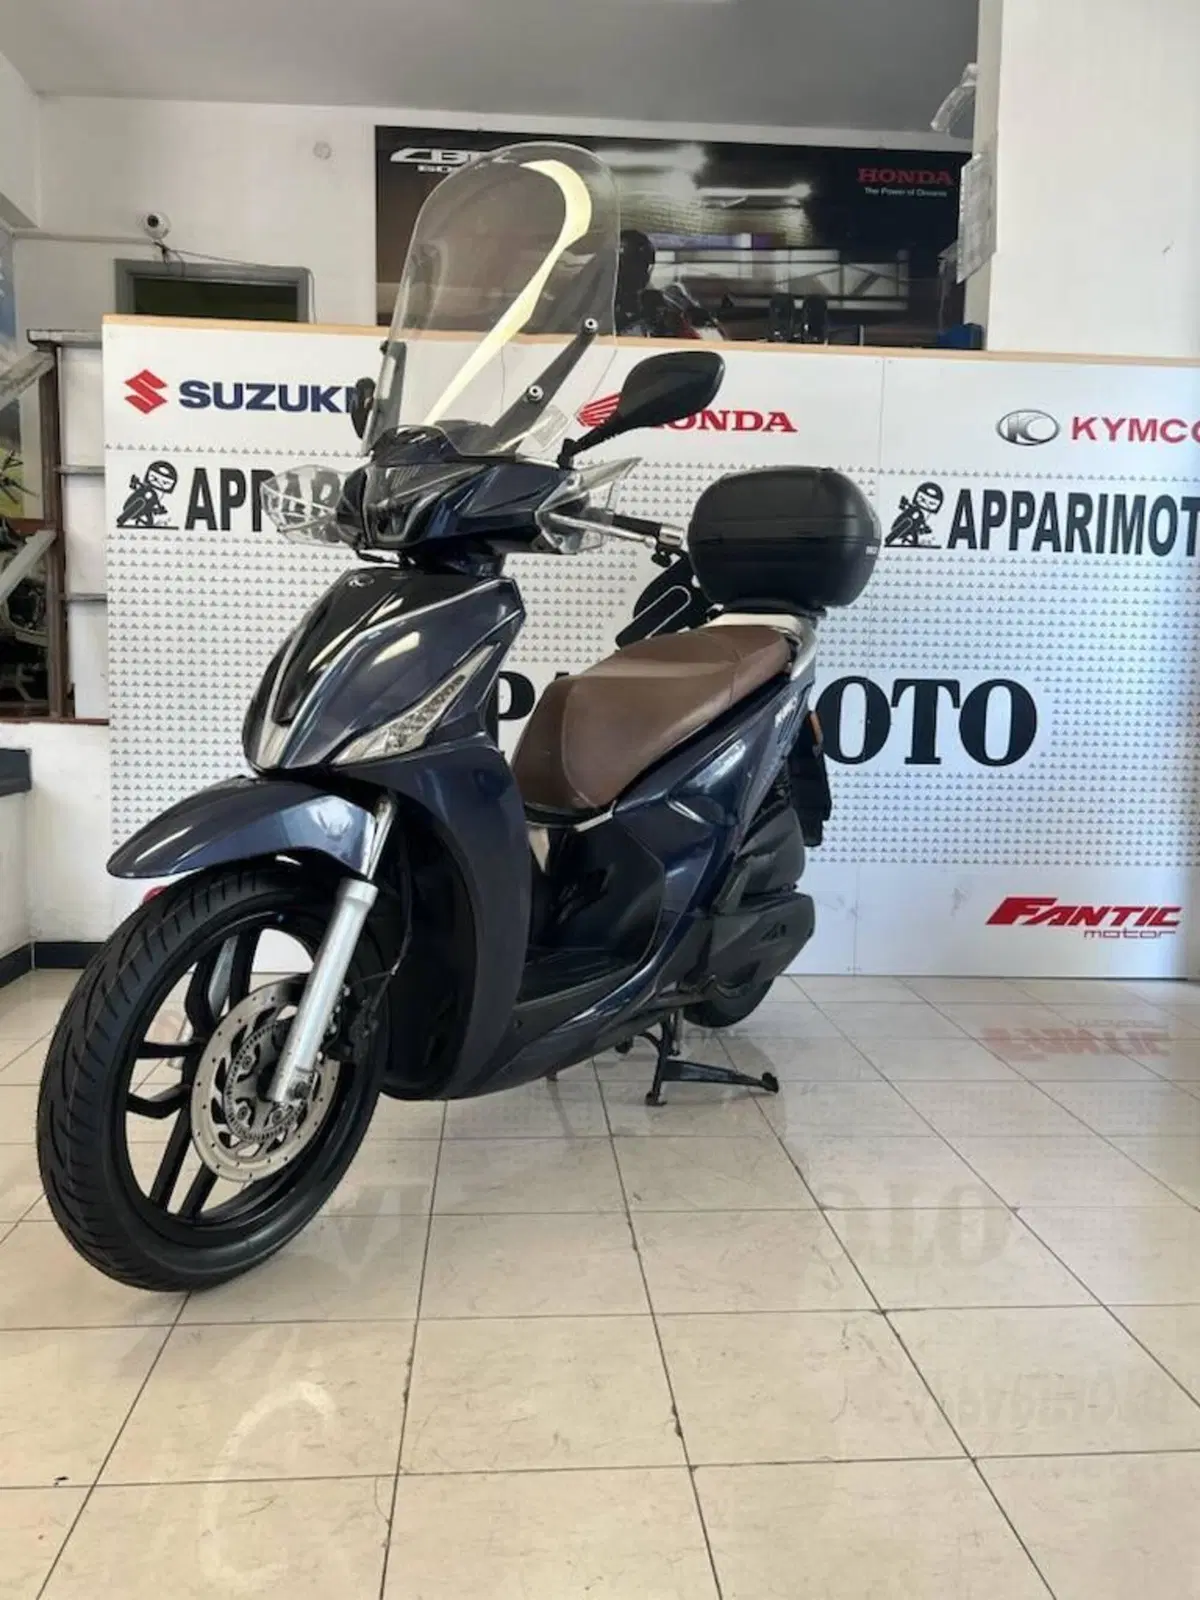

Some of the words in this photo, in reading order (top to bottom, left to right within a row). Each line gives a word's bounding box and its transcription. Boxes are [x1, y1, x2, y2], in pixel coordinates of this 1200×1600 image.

[857, 168, 953, 186] HONDA
[864, 187, 879, 195] The
[985, 896, 1182, 926] FANTIC
[1083, 927, 1176, 939] motor
